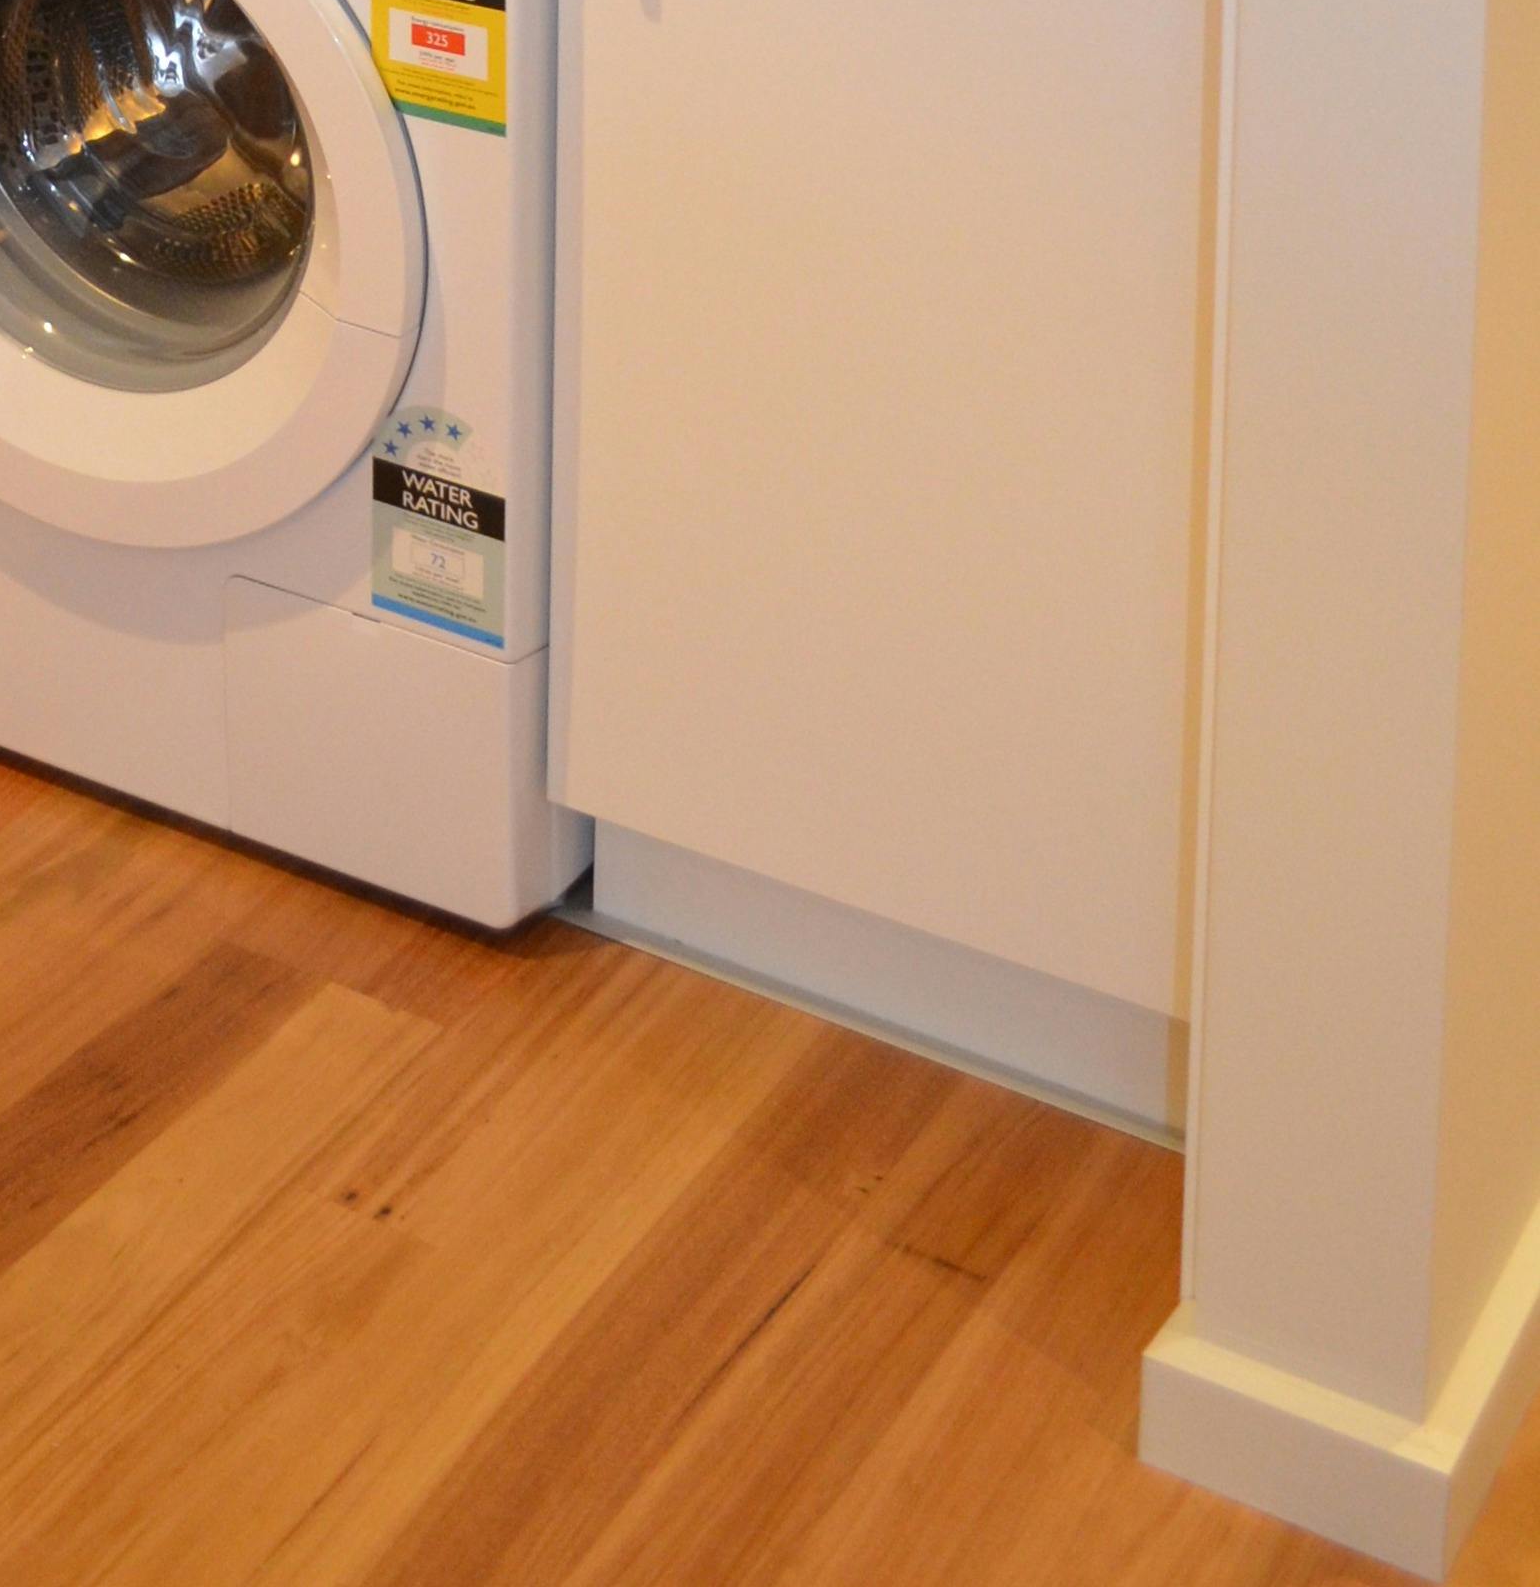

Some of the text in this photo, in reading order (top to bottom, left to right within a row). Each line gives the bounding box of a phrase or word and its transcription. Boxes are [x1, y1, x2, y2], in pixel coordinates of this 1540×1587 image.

[425, 31, 449, 47] 325
[402, 469, 473, 509] WATER
[402, 490, 479, 531] RATING
[430, 552, 446, 570] 72
